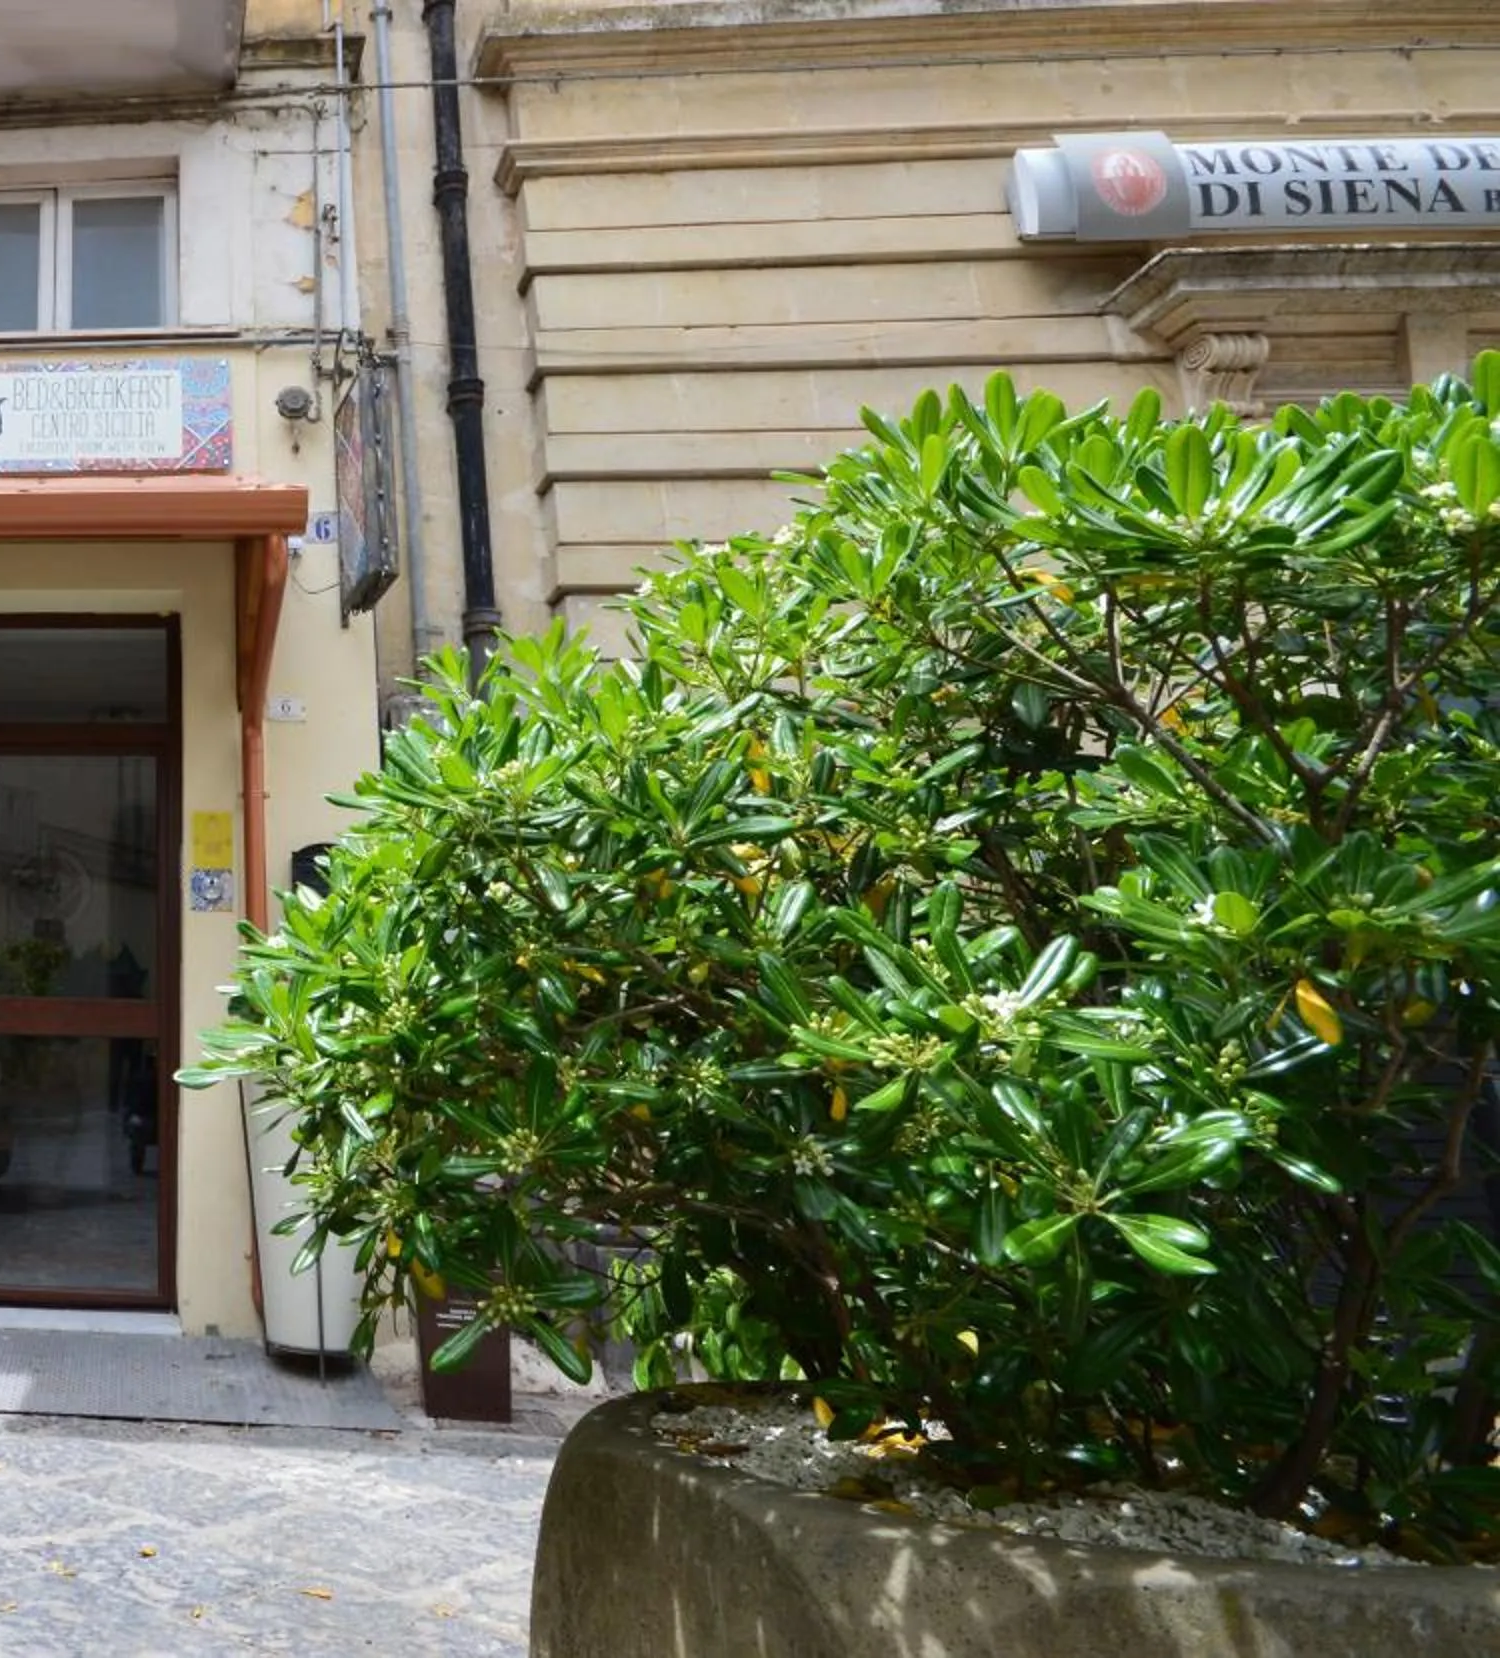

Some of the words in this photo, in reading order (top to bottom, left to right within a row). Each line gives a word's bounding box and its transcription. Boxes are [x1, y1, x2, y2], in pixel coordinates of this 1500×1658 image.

[1189, 142, 1409, 177] MONTE
[1197, 180, 1262, 217] DI
[1284, 176, 1467, 215] SIENA
[30, 411, 90, 439] CENTRO
[93, 410, 156, 438] SICILIA
[314, 517, 331, 541] 6
